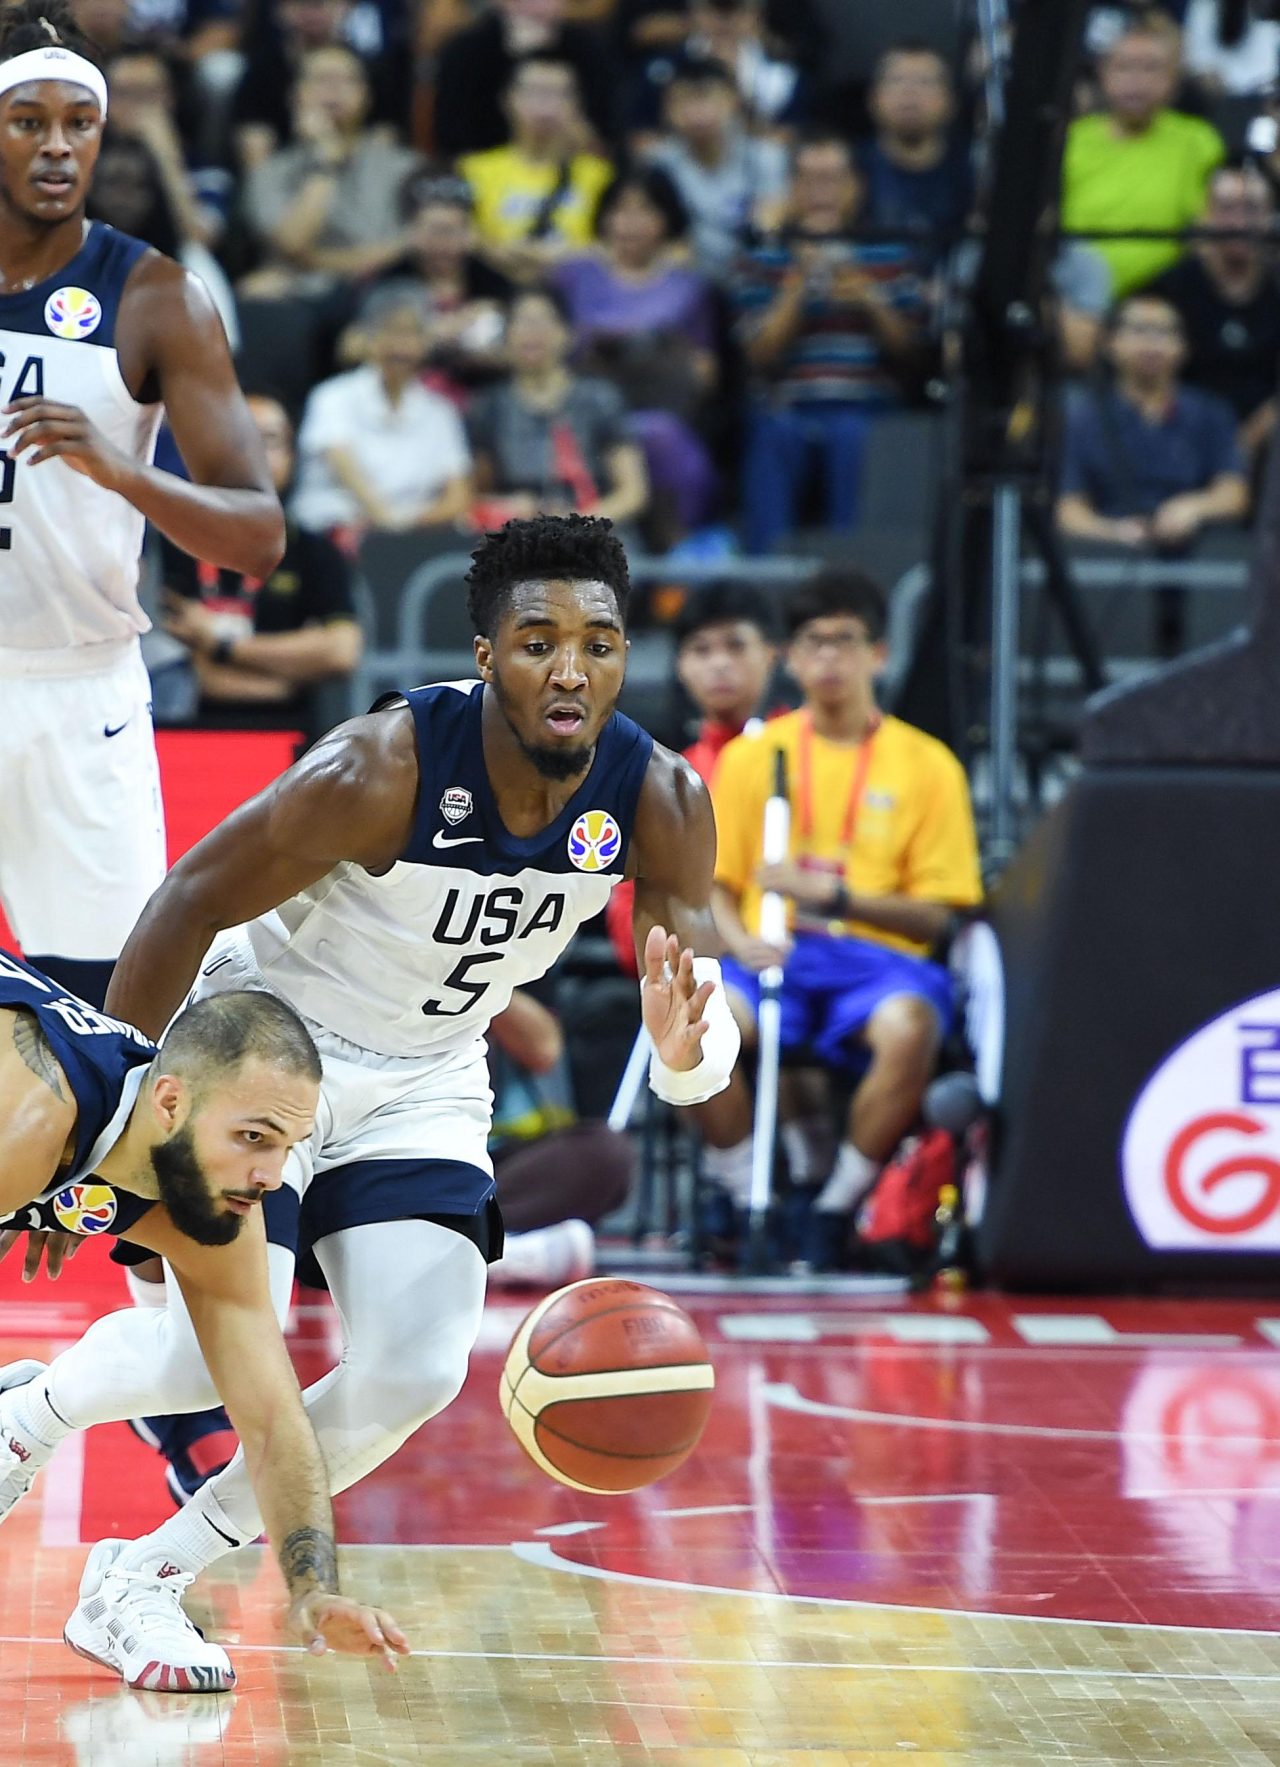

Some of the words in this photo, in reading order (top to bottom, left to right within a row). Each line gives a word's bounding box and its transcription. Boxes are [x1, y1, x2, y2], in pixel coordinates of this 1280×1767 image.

[448, 793, 467, 804] USA
[432, 887, 565, 945] USA
[422, 951, 505, 1016] 5
